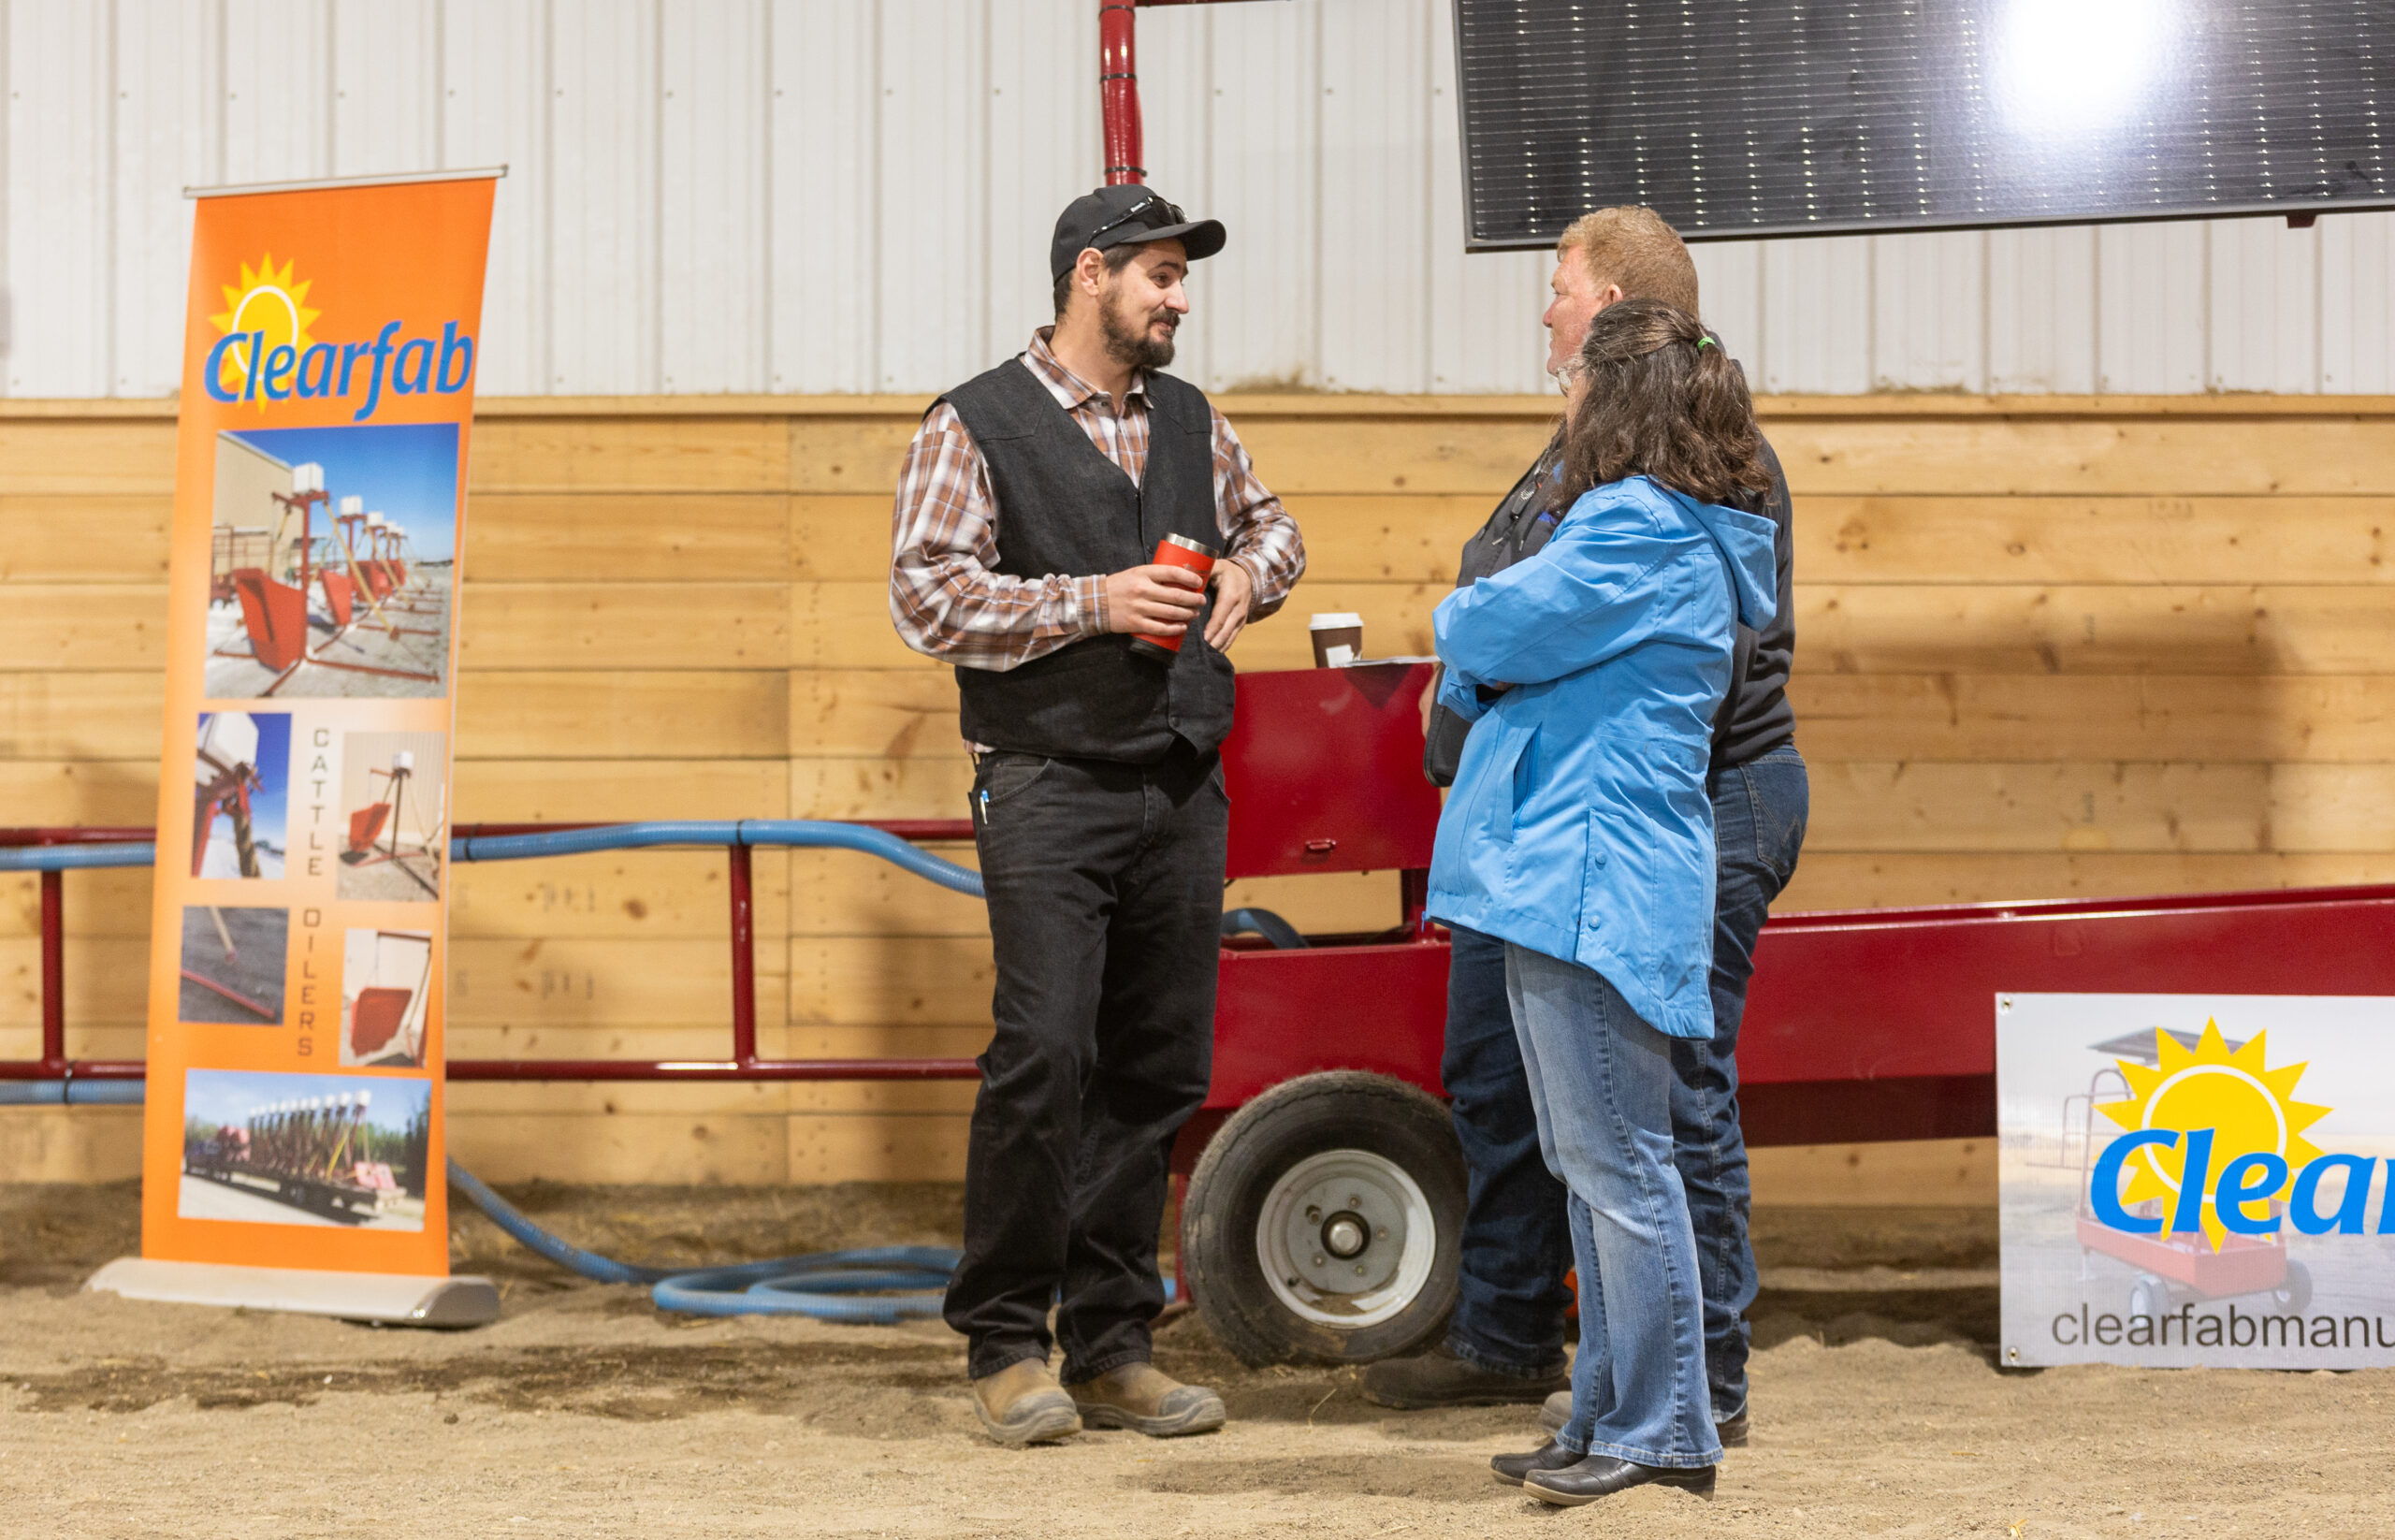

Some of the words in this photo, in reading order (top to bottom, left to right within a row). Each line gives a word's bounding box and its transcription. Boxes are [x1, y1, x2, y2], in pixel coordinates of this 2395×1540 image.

[203, 319, 474, 423] Clearfab
[307, 727, 329, 877] CATTLE
[297, 908, 321, 1057] OILERS
[2090, 1127, 2395, 1235] Clea
[2052, 1301, 2395, 1348] clearfabmanu
